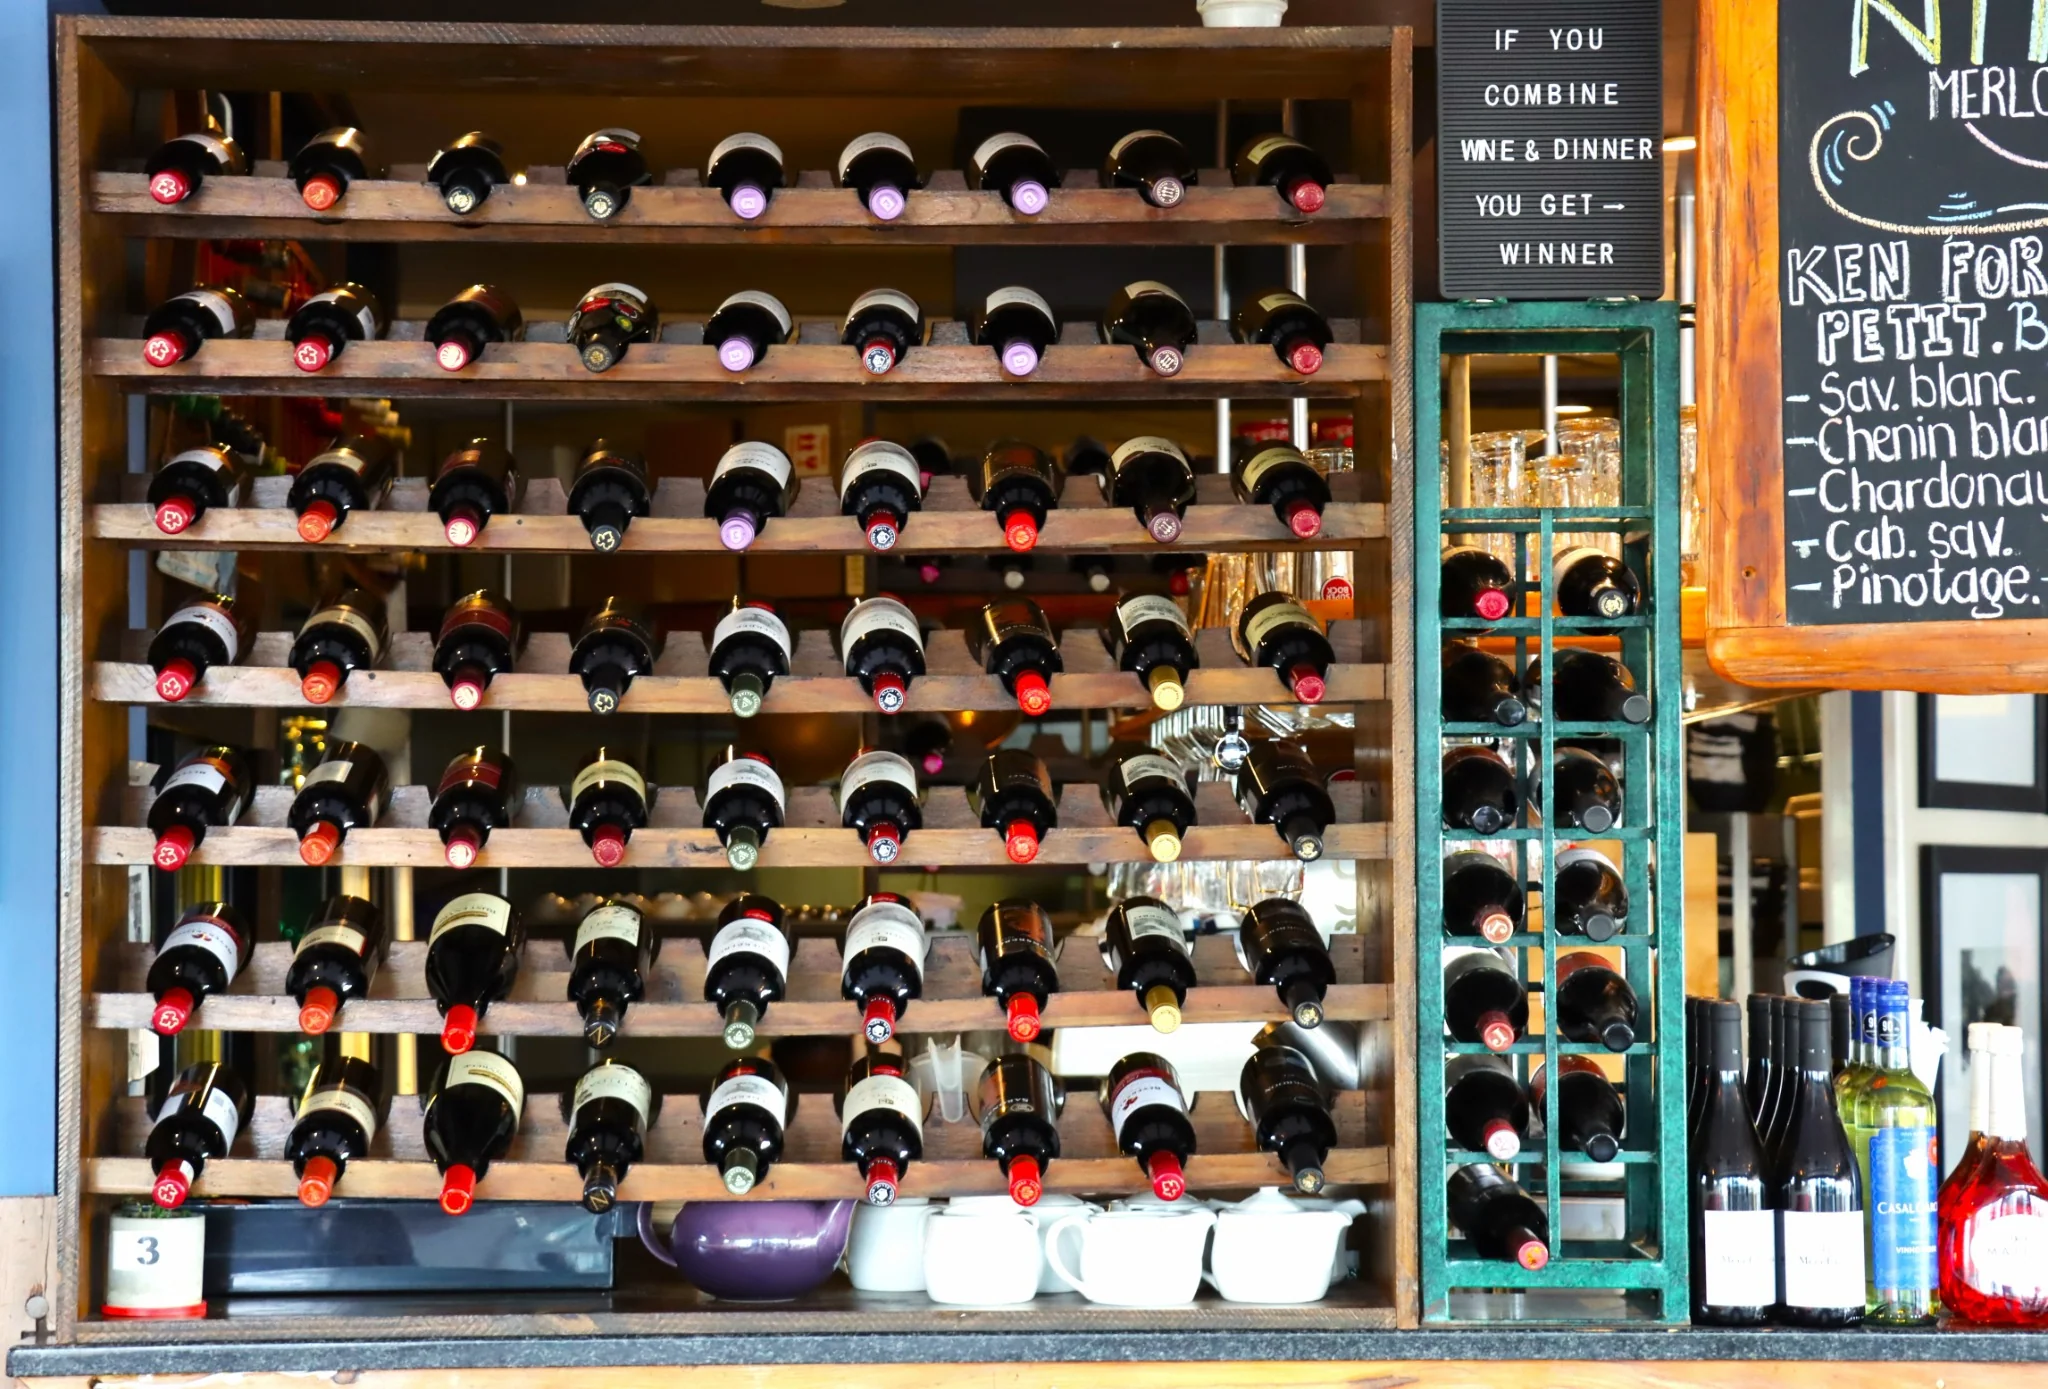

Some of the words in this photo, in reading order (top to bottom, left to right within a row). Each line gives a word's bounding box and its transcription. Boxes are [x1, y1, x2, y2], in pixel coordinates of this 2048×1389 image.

[1495, 28, 1520, 51] IF
[1549, 27, 1603, 51] YOU
[1484, 82, 1619, 107] COMBINE
[1524, 139, 1540, 162] &
[1553, 137, 1653, 161] DINNER
[1475, 193, 1522, 218] YOU
[1540, 192, 1593, 217] GET
[1499, 242, 1614, 266] WINNER
[1787, 240, 1910, 306] KEN
[1818, 370, 1900, 416] Sav.
[1909, 361, 2036, 409] blanc.
[1818, 414, 1958, 465] Chenin
[1825, 514, 1918, 562] Cab.
[1927, 516, 2014, 560] sav.
[1831, 557, 2041, 619] Pinotage.
[1877, 1201, 1915, 1215] CASAL
[135, 1235, 161, 1266] 3
